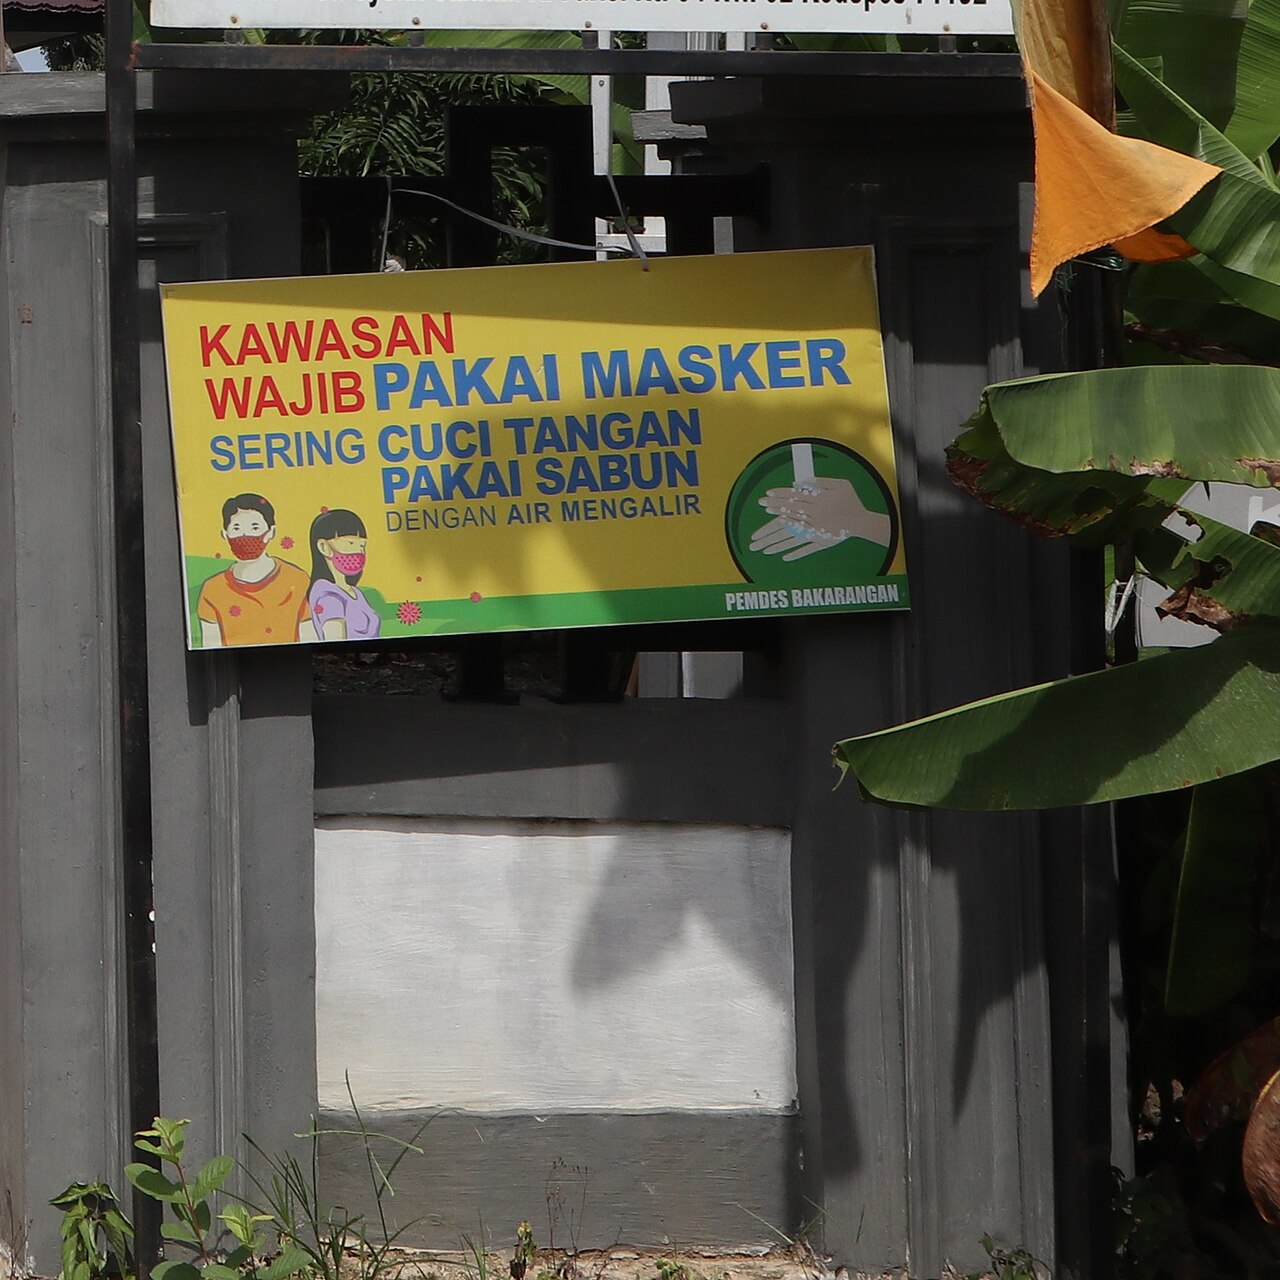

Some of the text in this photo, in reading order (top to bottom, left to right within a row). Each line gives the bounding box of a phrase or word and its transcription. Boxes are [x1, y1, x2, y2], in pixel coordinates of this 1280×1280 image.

[198, 312, 454, 367] KAWASAN
[206, 337, 852, 420] WAJIB PAKAI MASKER
[209, 408, 702, 472] SERING CUCI TANGAN
[381, 450, 699, 504] PAKAI SABUN
[386, 494, 702, 532] DENGAN AIR MENGALIR
[725, 583, 900, 612] PEMDES BAKARANGAN
